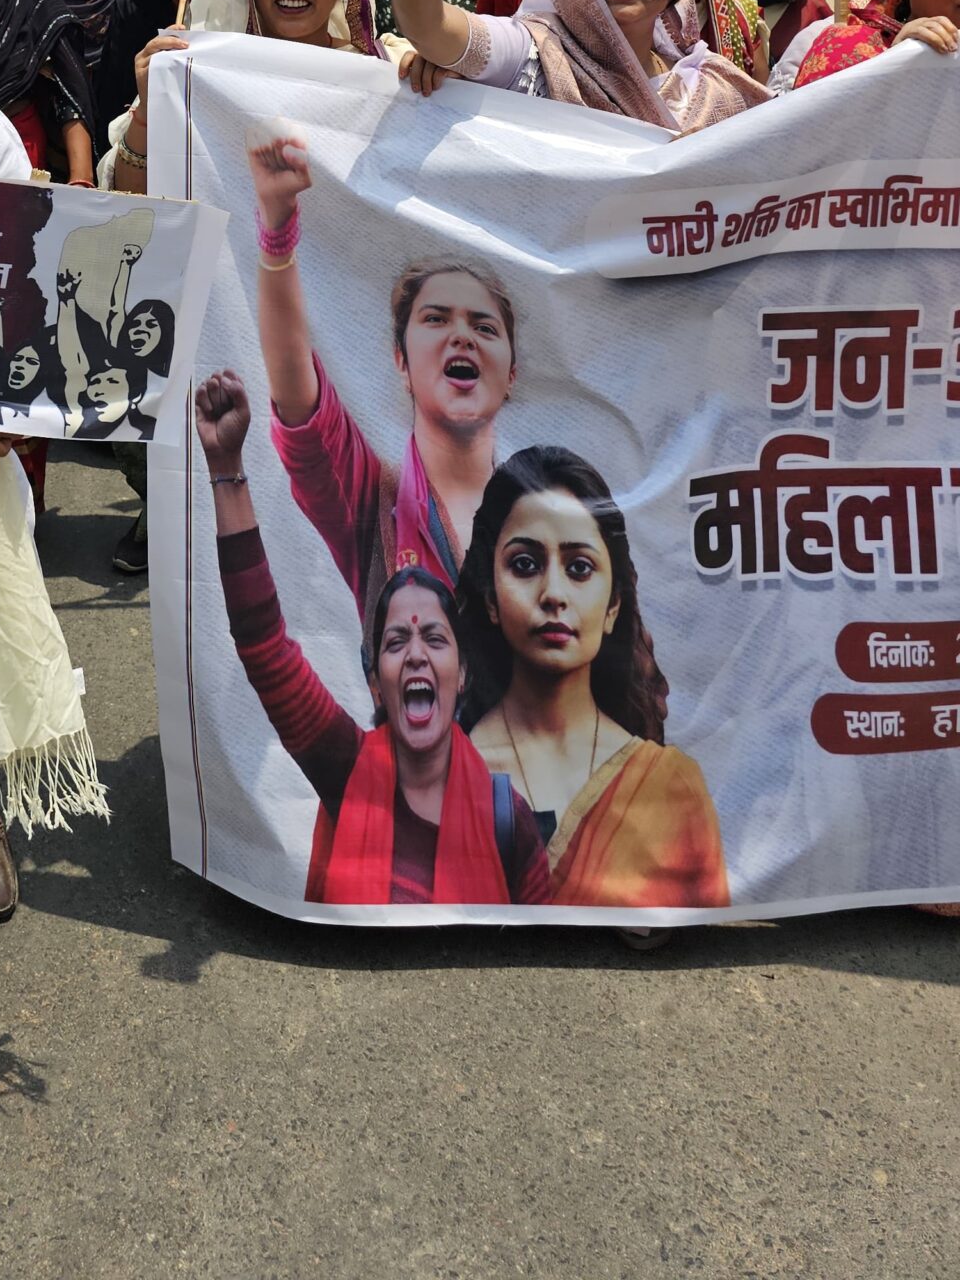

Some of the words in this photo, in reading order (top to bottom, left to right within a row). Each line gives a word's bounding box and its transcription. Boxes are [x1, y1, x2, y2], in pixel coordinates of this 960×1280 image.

[642, 200, 719, 257] नारी
[720, 194, 788, 249] शक्ति
[784, 190, 826, 230] का
[827, 174, 960, 228] स्वाभिमा
[690, 434, 942, 575] महिला
[867, 632, 935, 668] दिनांक:
[843, 710, 905, 739] स्थान:
[931, 704, 960, 738] हा
